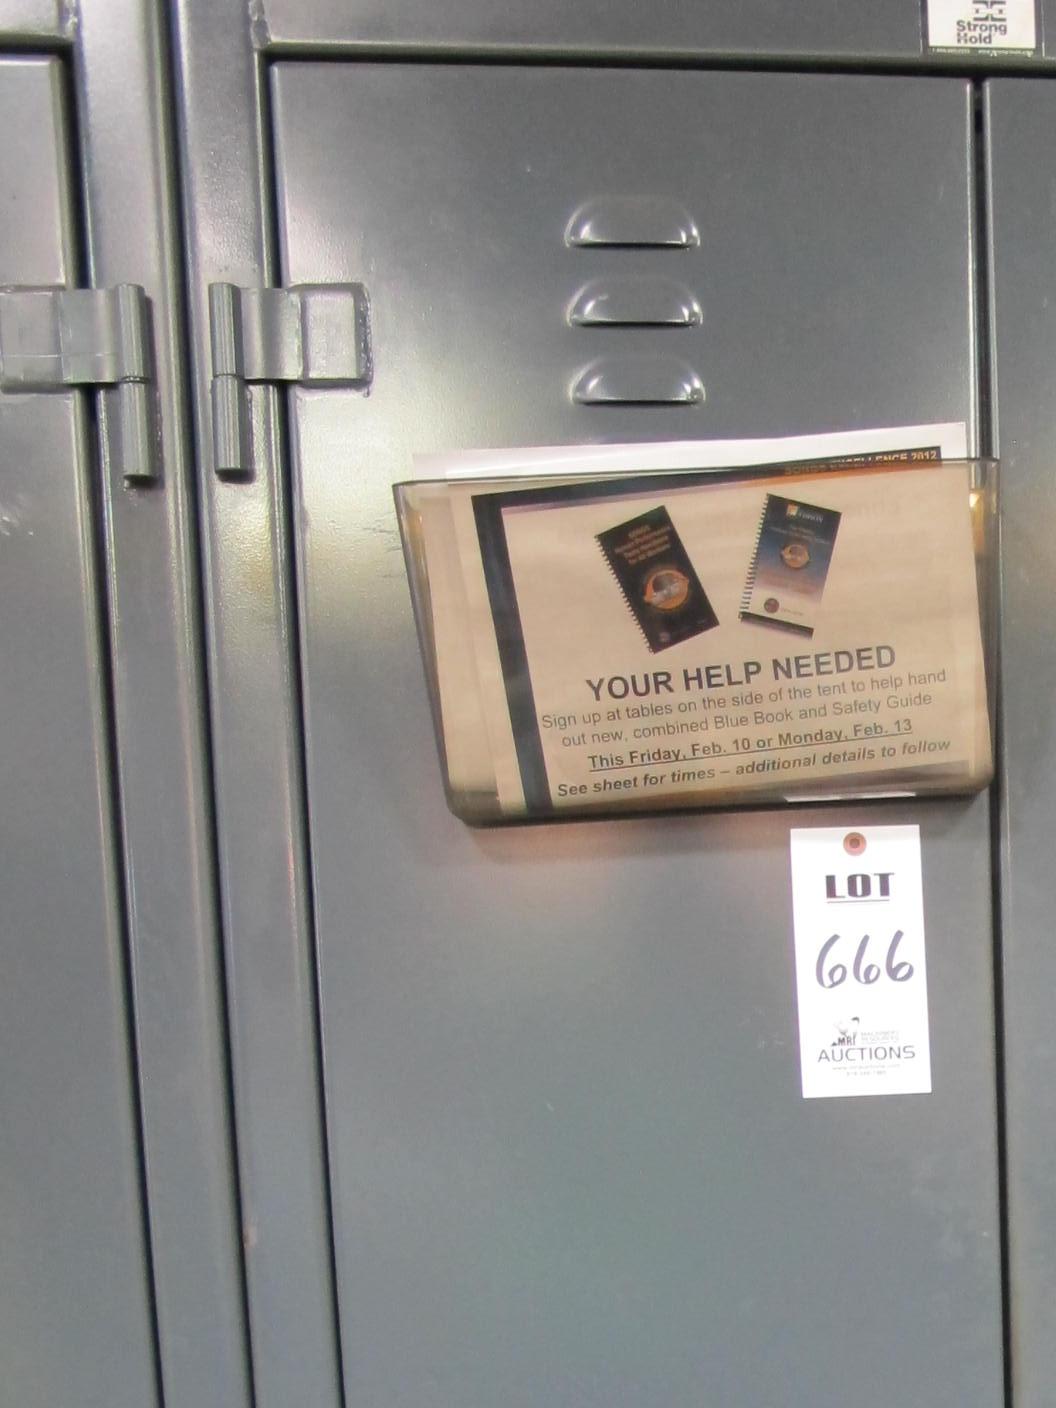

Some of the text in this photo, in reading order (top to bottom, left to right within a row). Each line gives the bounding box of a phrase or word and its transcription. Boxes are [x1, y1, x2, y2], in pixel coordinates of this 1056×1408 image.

[956, 19, 1008, 36] Strong
[956, 33, 993, 45] Hold
[542, 669, 947, 730] Sign up at tables on the side of the tent to help hand
[586, 645, 896, 702] YOUR HELP NEEDED
[562, 692, 932, 747] out new, combined Blue Book and Safety Guide
[587, 718, 912, 770] This Friday, Feb. 10 or Monday, Feb. 13
[558, 783, 588, 797] See
[592, 776, 639, 793] sheet
[643, 772, 667, 787] for
[671, 768, 716, 783] times
[735, 753, 816, 775] additional
[822, 747, 876, 765] details
[881, 745, 896, 758] to
[902, 738, 951, 755] follow
[825, 872, 895, 899] LOT
[815, 929, 914, 989] 666
[817, 1045, 916, 1062] AUCTIONS
